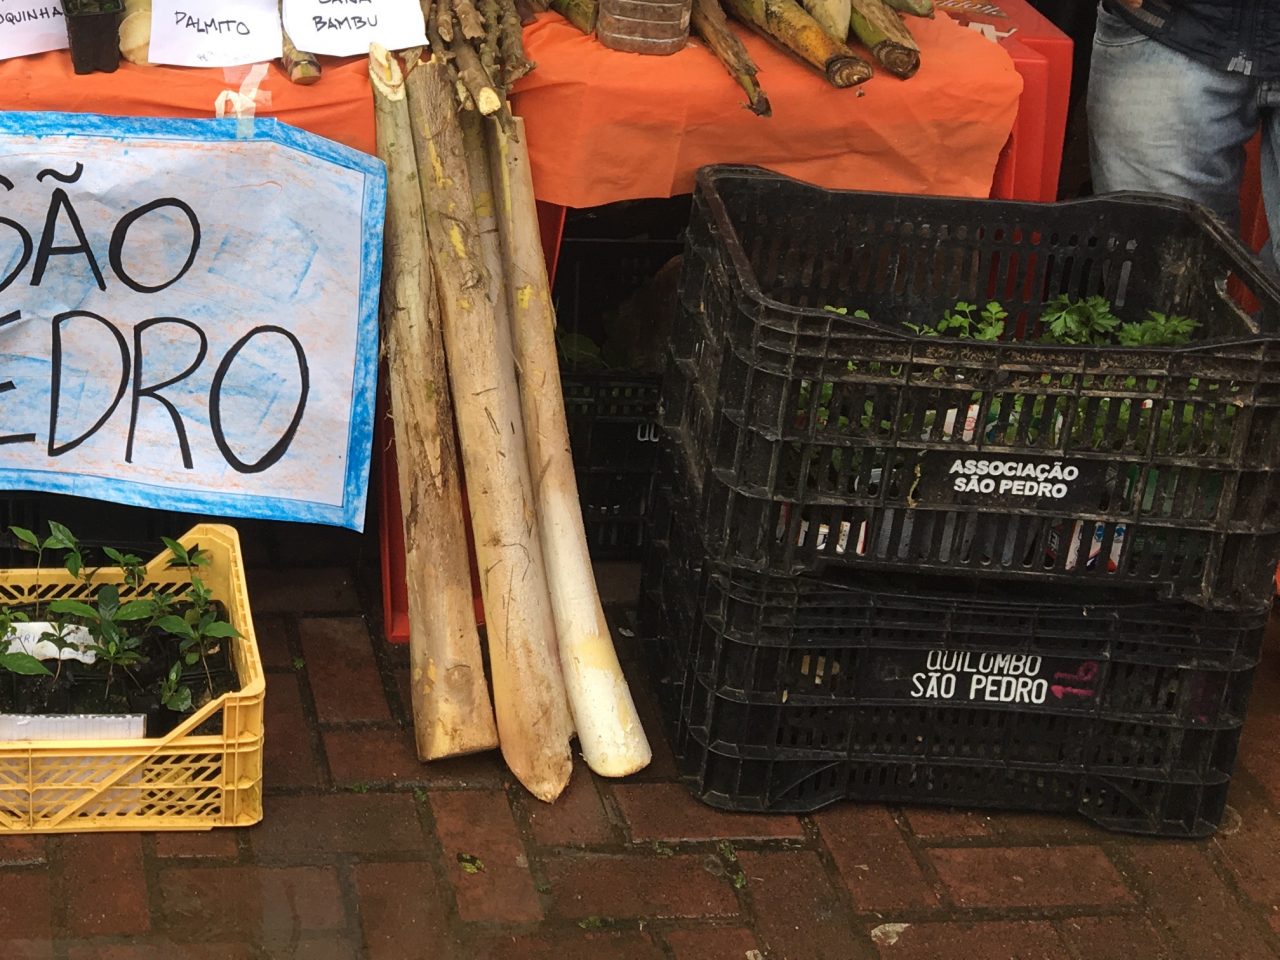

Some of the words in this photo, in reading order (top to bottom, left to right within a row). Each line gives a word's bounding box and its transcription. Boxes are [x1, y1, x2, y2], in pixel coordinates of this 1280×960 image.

[174, 10, 251, 36] PALMITO
[312, 14, 378, 32] BAMBU
[948, 459, 1080, 482] ASSOCIAÇÃO
[953, 475, 996, 493] SÃO
[999, 479, 1068, 499] PEDRO
[926, 650, 1043, 677] QUILOMBO
[910, 671, 957, 699] SÃO
[969, 673, 1049, 705] PEDRO
